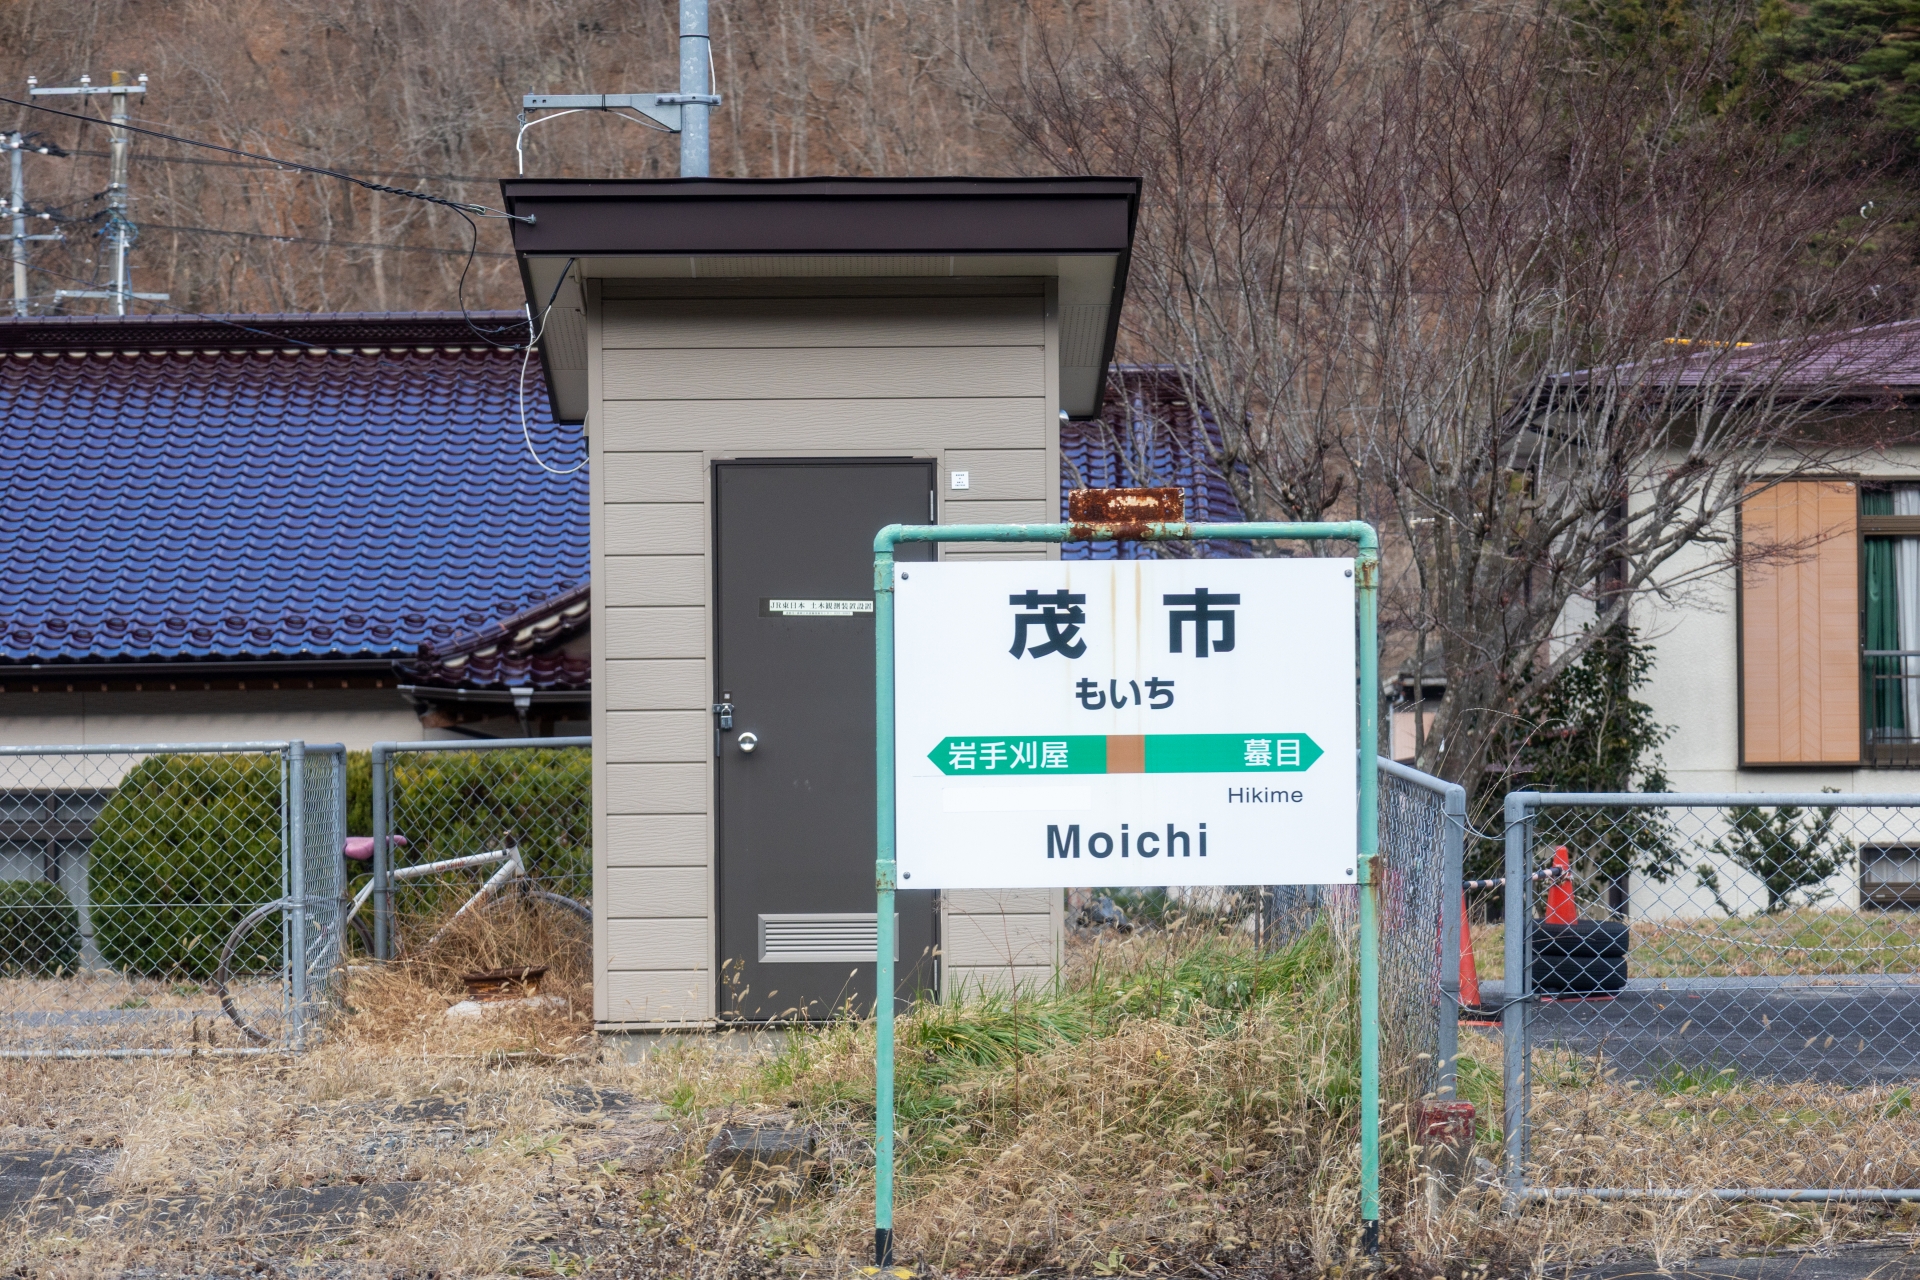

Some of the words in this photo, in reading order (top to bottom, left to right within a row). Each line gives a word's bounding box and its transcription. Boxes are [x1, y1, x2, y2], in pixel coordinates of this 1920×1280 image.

[770, 601, 805, 610] JR東日本
[1009, 588, 1240, 659] 茂市
[1076, 677, 1175, 710] もいち
[949, 741, 1069, 770] 岩手刈屋
[1244, 739, 1299, 766] 蟇目
[1228, 786, 1303, 804] Hikime
[1047, 823, 1207, 858] Moichi
